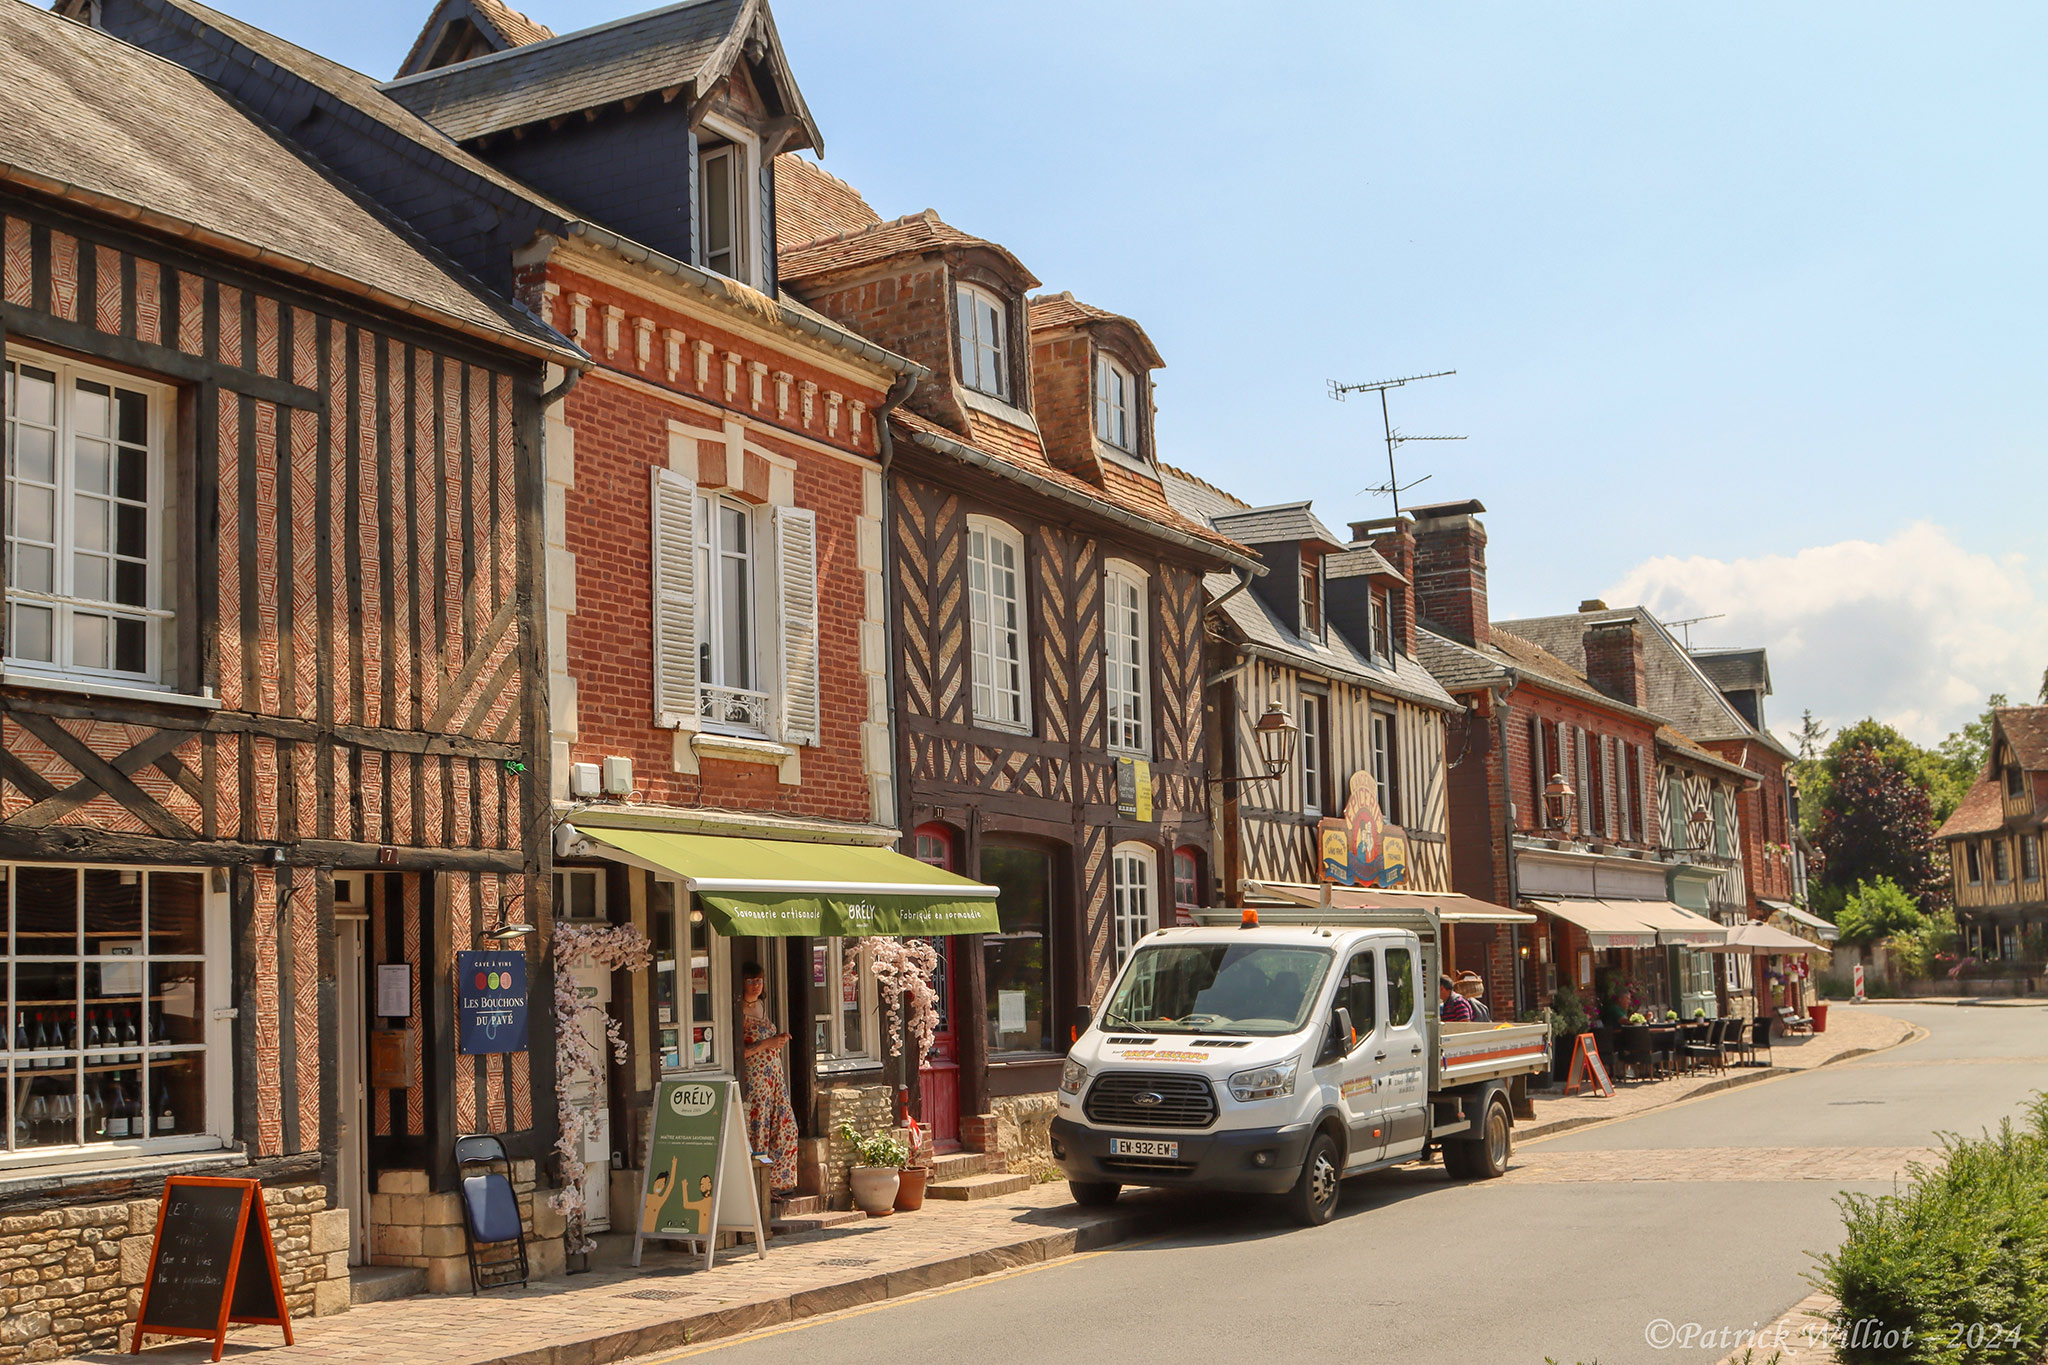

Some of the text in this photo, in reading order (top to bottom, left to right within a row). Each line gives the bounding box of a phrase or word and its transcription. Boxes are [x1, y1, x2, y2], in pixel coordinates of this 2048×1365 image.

[386, 849, 392, 861] 7
[734, 906, 821, 919] Savonnerie artisanale
[900, 909, 931, 923] Fabriqué
[946, 908, 981, 919] normandie
[481, 996, 525, 1008] BOUCHONS
[476, 1013, 514, 1026] DU PAVÉ
